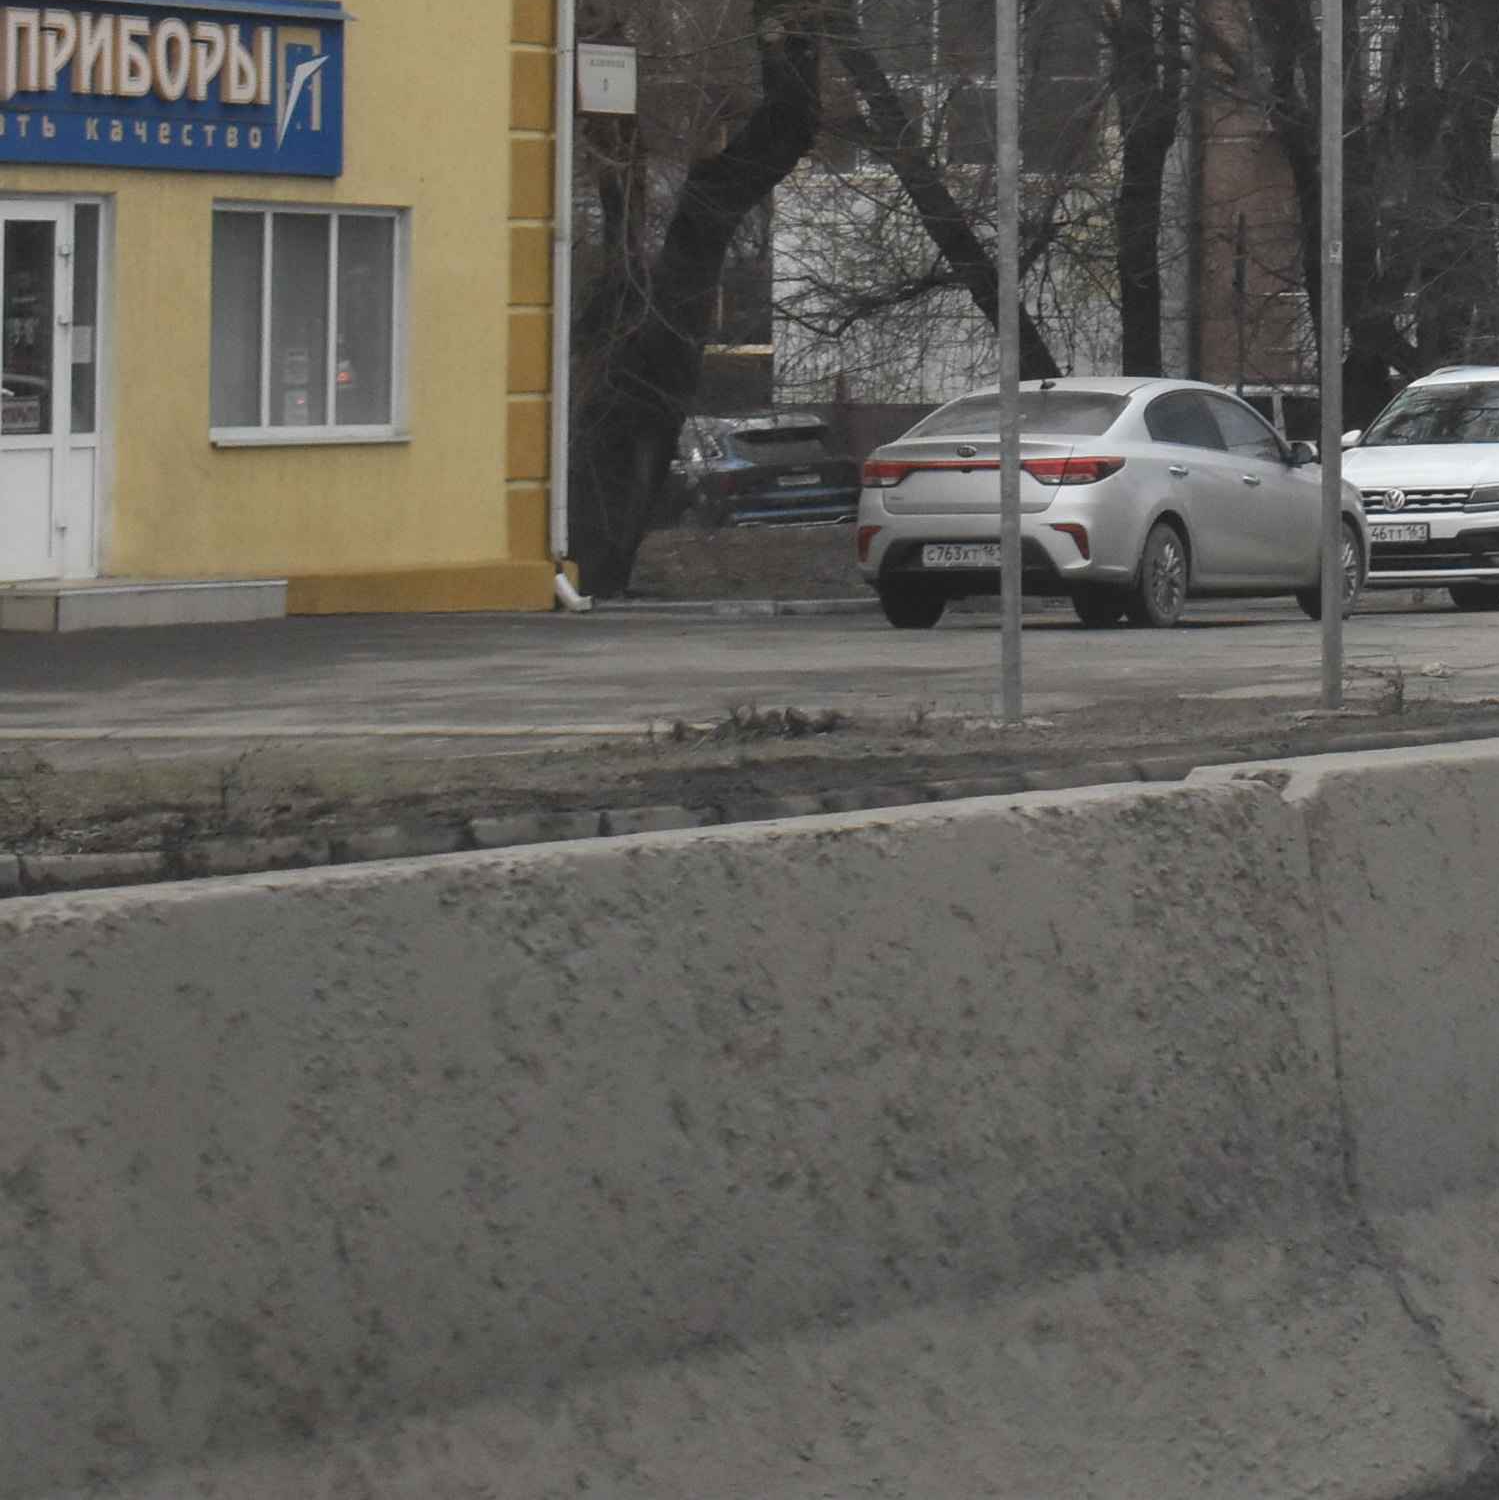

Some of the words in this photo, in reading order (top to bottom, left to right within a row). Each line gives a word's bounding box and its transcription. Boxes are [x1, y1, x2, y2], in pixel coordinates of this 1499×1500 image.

[1, 6, 272, 106] ПРИБОРЫ
[0, 113, 56, 139] ть
[86, 117, 262, 149] качество
